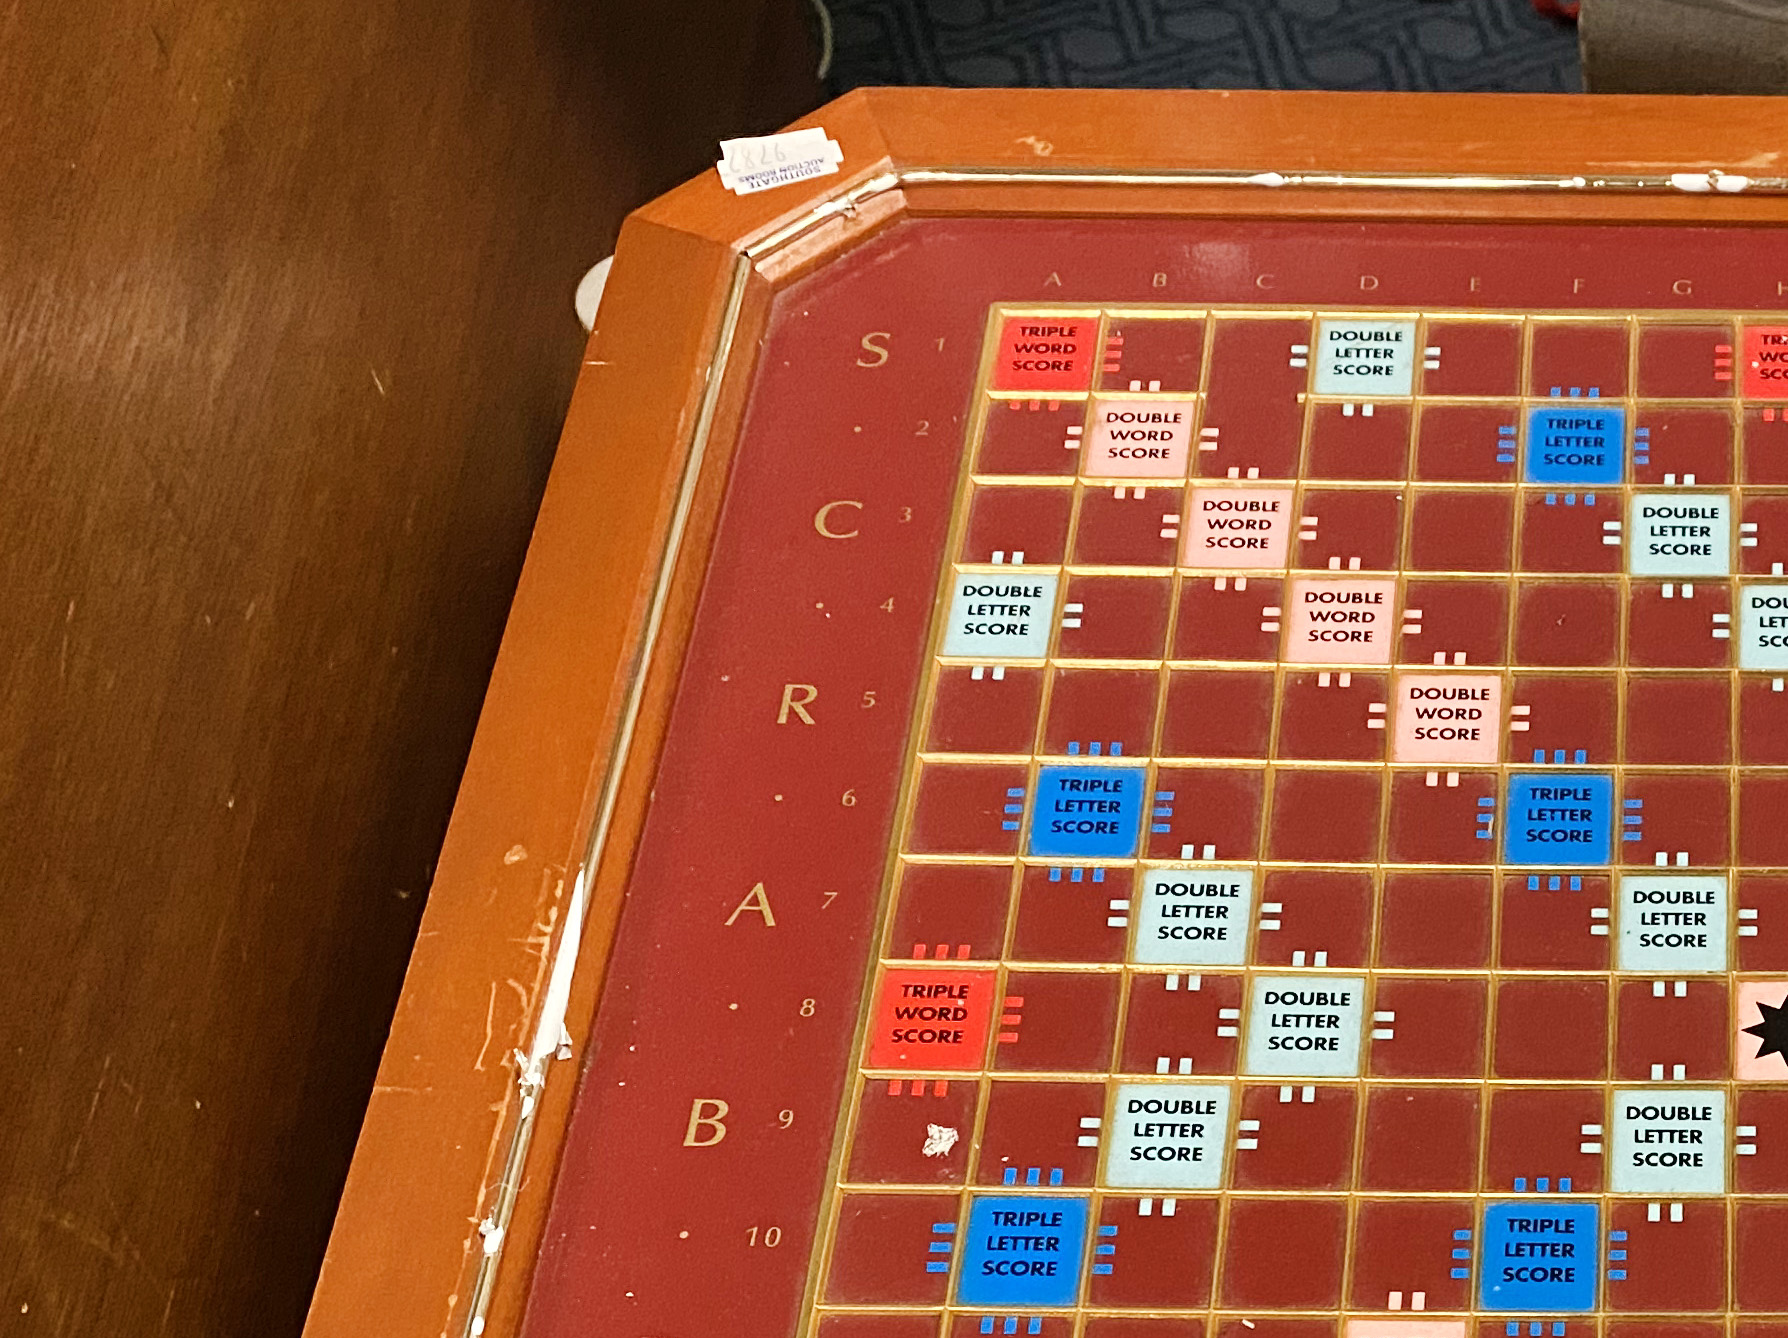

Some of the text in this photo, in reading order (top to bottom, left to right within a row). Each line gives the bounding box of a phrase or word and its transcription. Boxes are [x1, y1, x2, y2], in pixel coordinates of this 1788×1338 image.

[737, 157, 825, 183] AUCTION ROOMS
[748, 165, 822, 190] SOUTHGATE
[1043, 270, 1064, 288] A
[1151, 271, 1169, 289] B
[1358, 274, 1380, 292] D
[1671, 278, 1693, 296] G
[1020, 325, 1076, 338] TRIPLE
[1328, 329, 1403, 343] DOUBLE
[1014, 342, 1078, 355] WORD
[1334, 346, 1395, 360] LETTER
[1012, 359, 1072, 372] SCORE
[1332, 363, 1394, 377] SCORE
[1105, 411, 1181, 425] DOUBLE
[1109, 429, 1174, 442] WORD
[1107, 446, 1171, 460] SCORE
[898, 505, 914, 524] 3
[961, 584, 1044, 599] DOUBLE
[966, 603, 1032, 618] LETTER
[962, 621, 1030, 637] SCORE
[860, 689, 878, 710] 5
[1409, 686, 1491, 702] DOUBLE
[1414, 706, 1483, 721] WORD
[1413, 726, 1481, 742] SCORE
[840, 787, 858, 808] 6
[902, 983, 970, 1001] TRIPLE
[798, 997, 817, 1019] 8
[894, 1006, 969, 1023] WORD
[891, 1028, 963, 1045] SCORE
[1126, 1098, 1218, 1116] DOUBLE
[1132, 1121, 1206, 1139] LETTER
[1128, 1145, 1204, 1163] SCORE
[746, 1225, 783, 1249] 10
